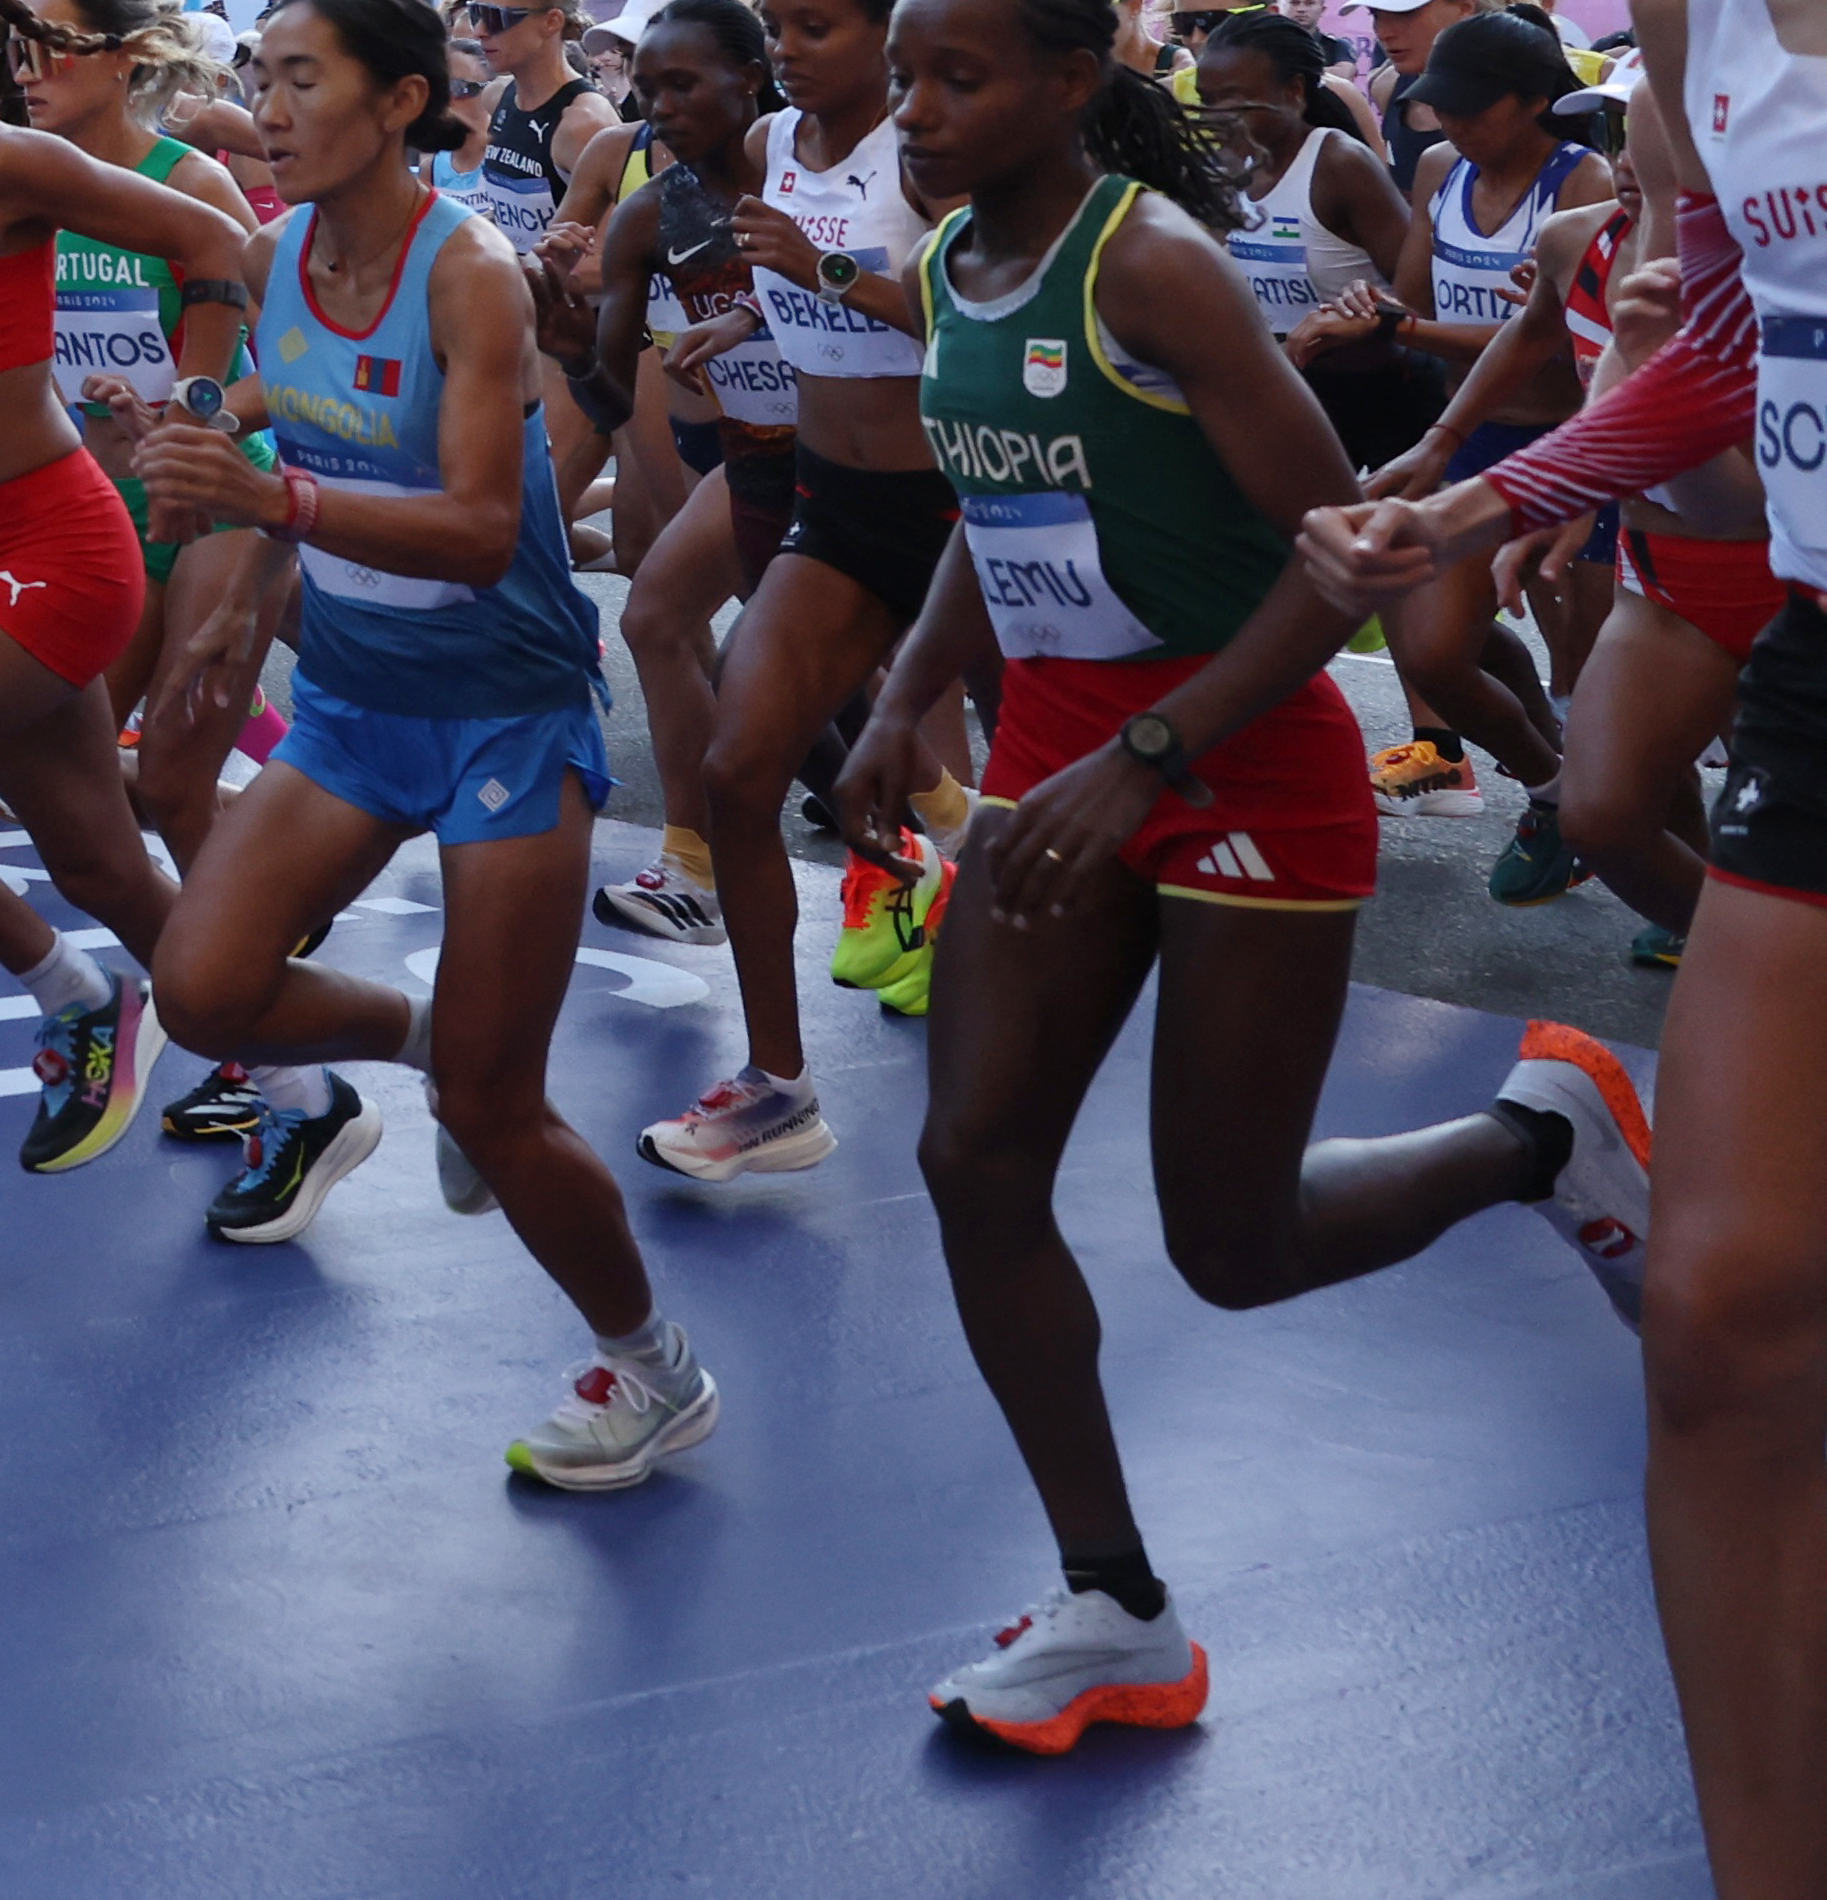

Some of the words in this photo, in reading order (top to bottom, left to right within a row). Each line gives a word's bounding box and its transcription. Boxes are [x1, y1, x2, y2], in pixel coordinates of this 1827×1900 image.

[499, 147, 543, 178] ZEALAND
[262, 381, 400, 450] MONGOLIA
[81, 1026, 115, 1109] HOKA
